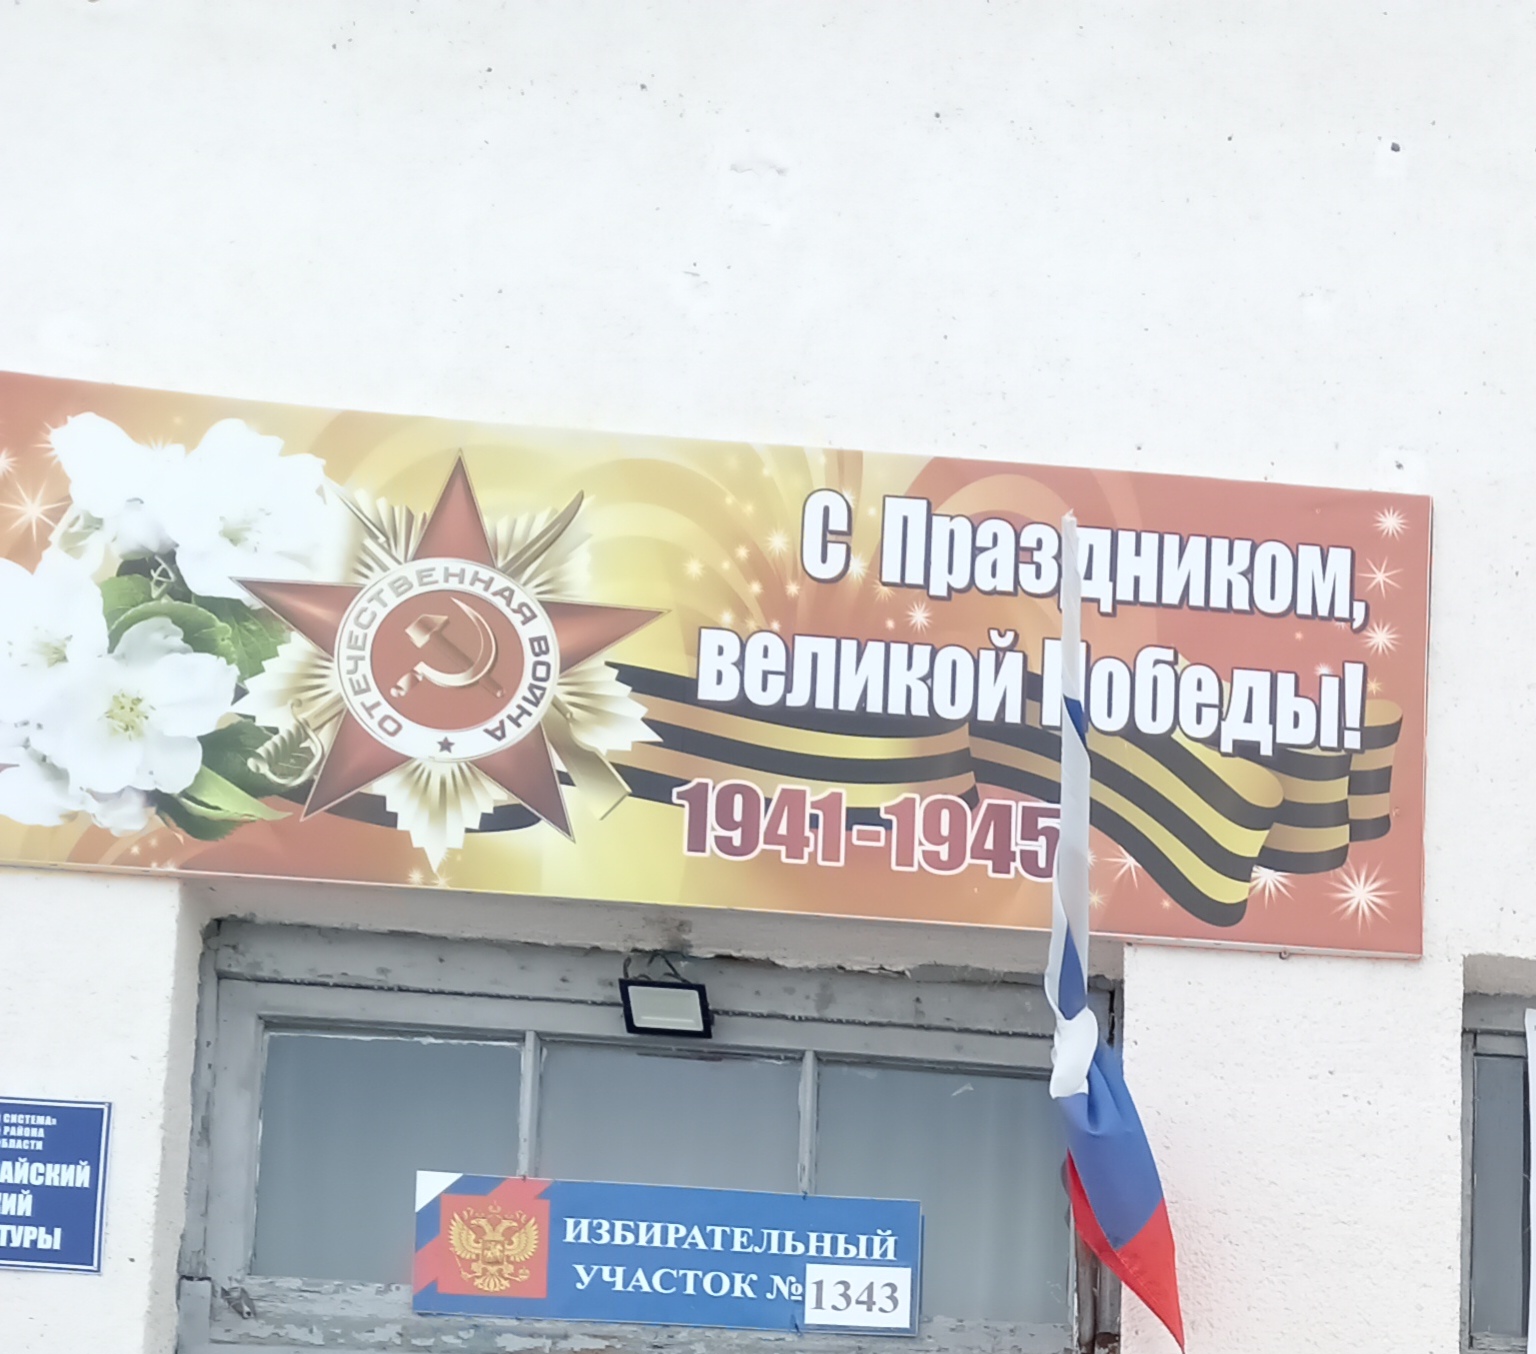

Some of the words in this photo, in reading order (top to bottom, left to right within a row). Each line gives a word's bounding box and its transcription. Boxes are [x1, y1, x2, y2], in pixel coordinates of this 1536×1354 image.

[801, 488, 852, 583] С
[880, 494, 1369, 633] Праздником,
[346, 566, 538, 738] ОТЕЧЕСТВЕННАЯ
[696, 626, 1029, 726] великой
[672, 777, 1062, 882] 1941-1945
[0, 1138, 43, 1151] БЛАСТИ
[3, 1125, 45, 1138] РАЙОНА
[0, 1188, 33, 1217] ИЙ
[563, 1217, 899, 1261] ИЗБИРАТЕЛЬНЫЙ
[572, 1263, 758, 1299] УЧАСТОК
[765, 1274, 804, 1301] №
[809, 1278, 900, 1314] 1343
